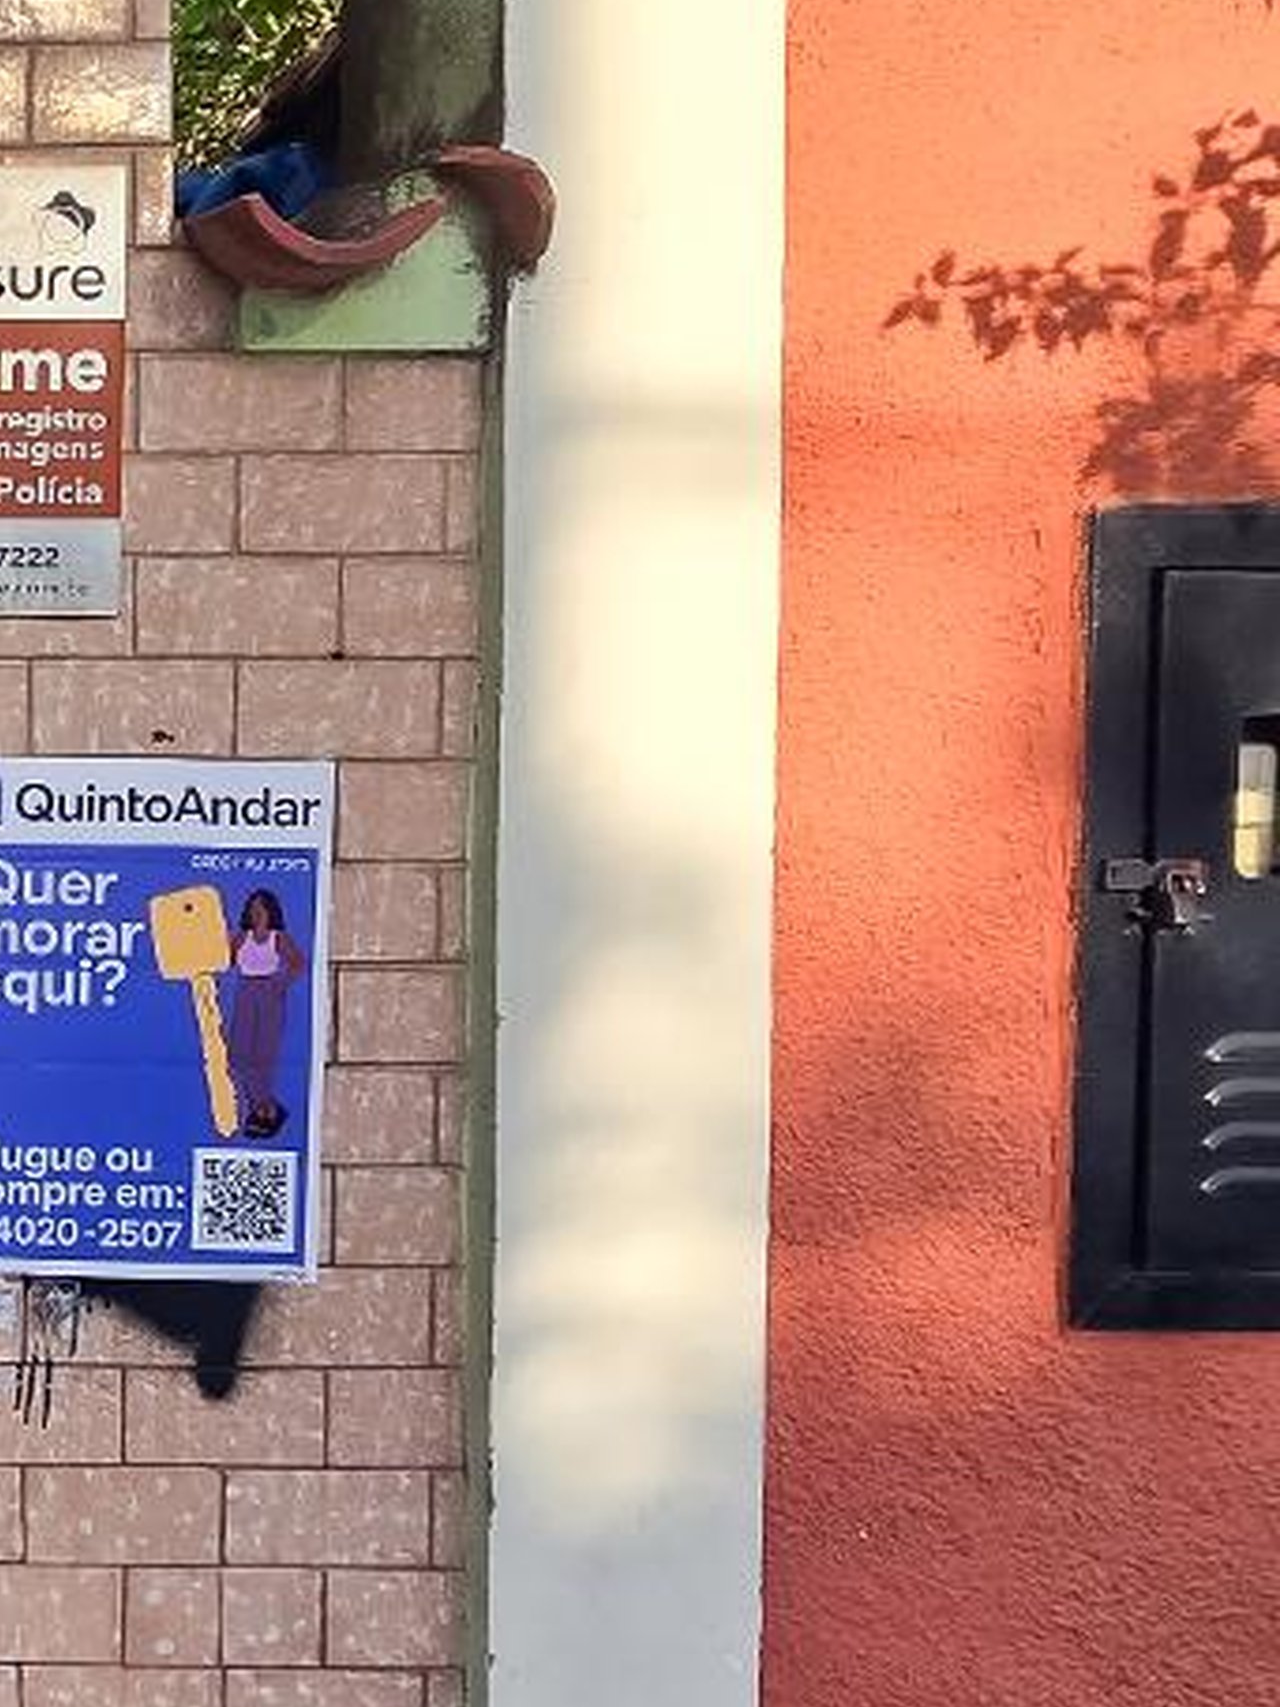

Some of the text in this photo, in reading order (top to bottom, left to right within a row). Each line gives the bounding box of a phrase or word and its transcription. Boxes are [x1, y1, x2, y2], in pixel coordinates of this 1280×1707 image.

[15, 780, 323, 829] QuintoAndar
[104, 1145, 153, 1173] ou
[115, 1179, 187, 1211] em:
